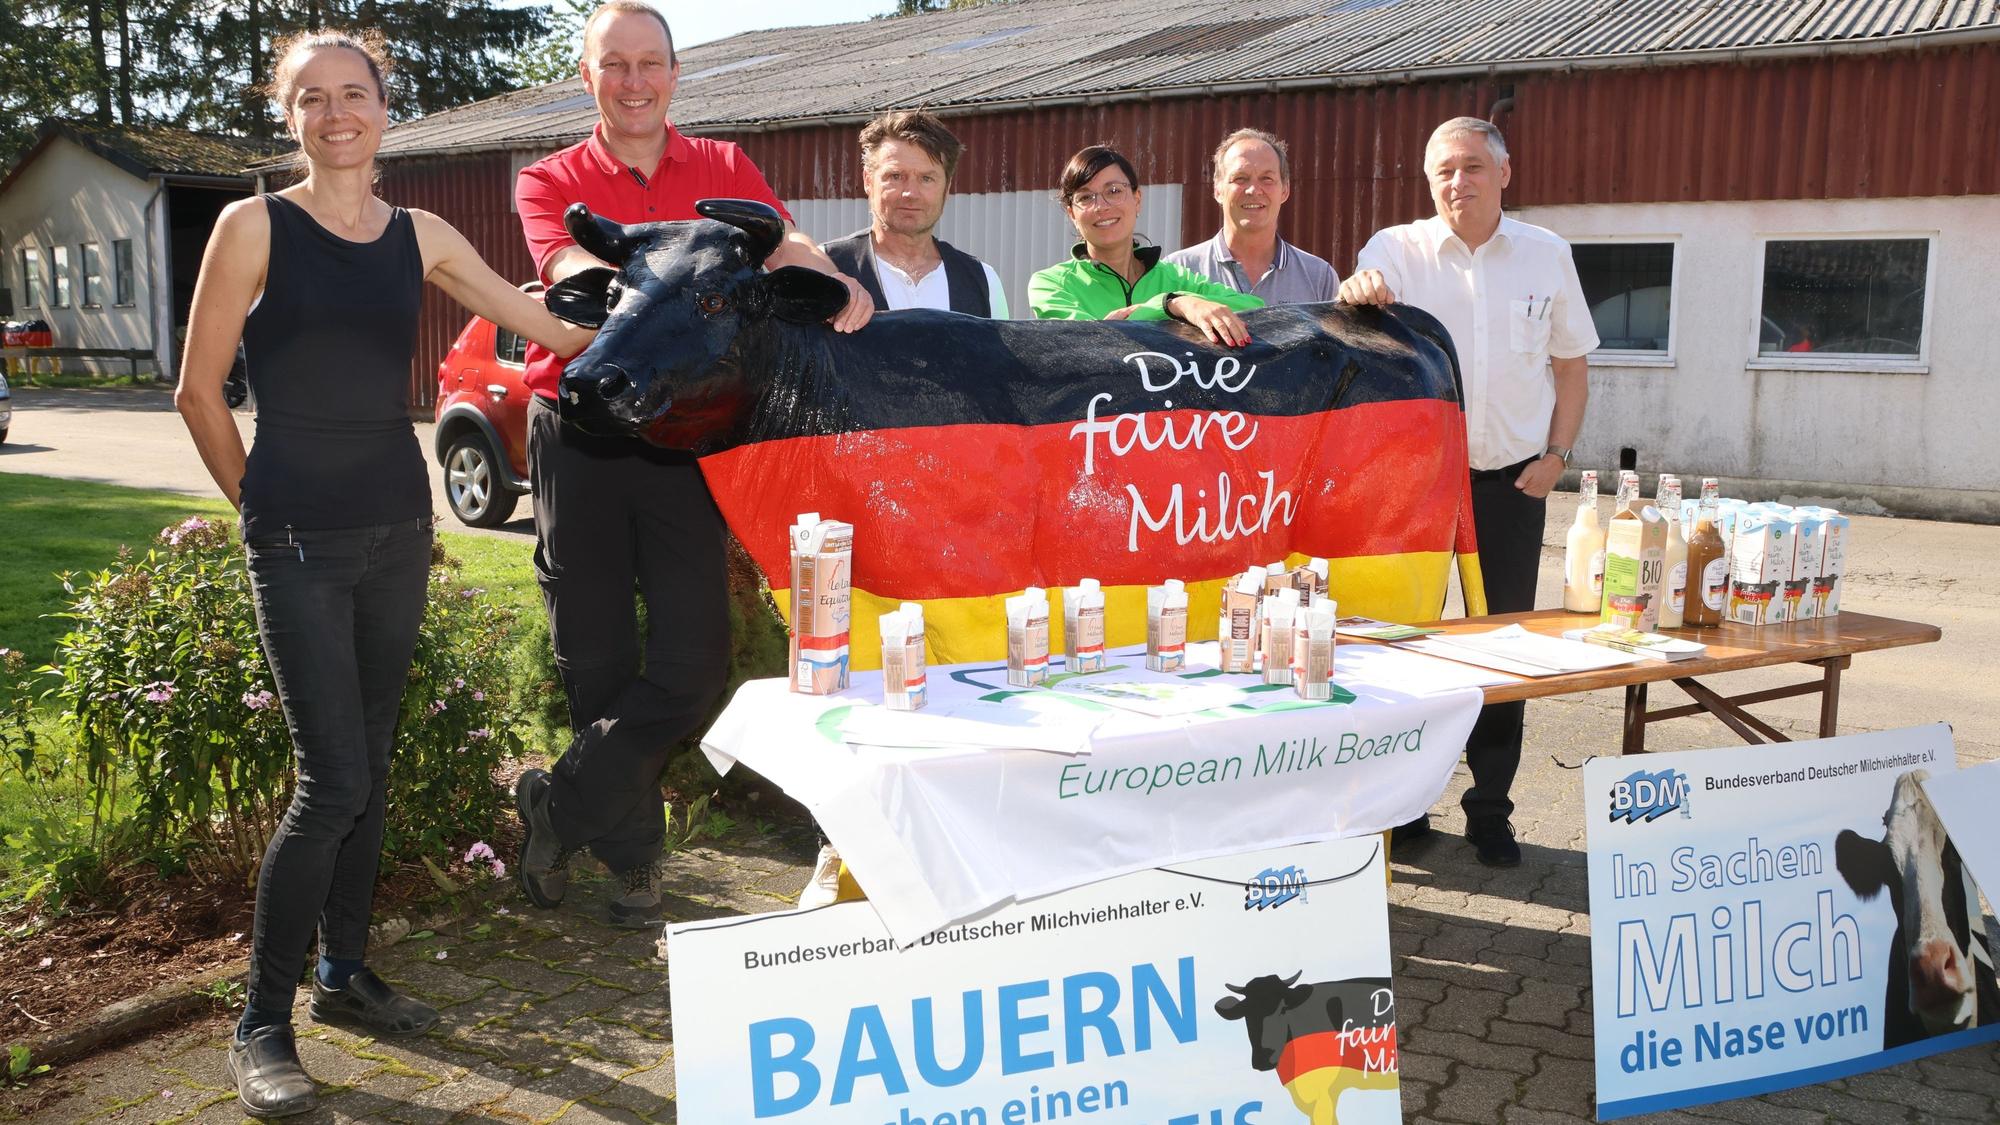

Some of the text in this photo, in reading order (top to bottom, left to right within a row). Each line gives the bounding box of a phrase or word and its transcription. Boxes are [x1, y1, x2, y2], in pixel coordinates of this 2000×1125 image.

[1123, 351, 1257, 393] Die
[1069, 392, 1259, 475] faire
[1125, 469, 1301, 552] Milch
[1642, 559, 1663, 585] BIO
[1058, 719, 1427, 800] European Milk Board
[1705, 749, 1938, 791] Bundesverband Deutscher Milchviehhalter e.V.
[1613, 776, 1685, 812] BDM
[1248, 871, 1304, 901] BDM
[1612, 837, 1823, 899] In Sachen
[744, 936, 914, 970] Bundesverba
[1030, 897, 1171, 932] Milchviehhalter
[1175, 892, 1205, 910] e.V.
[1617, 889, 1863, 1018] Milch
[747, 956, 1200, 1120] BAUERN
[1620, 1004, 1869, 1074] die Nase vorn
[1001, 1079, 1129, 1125] einen
